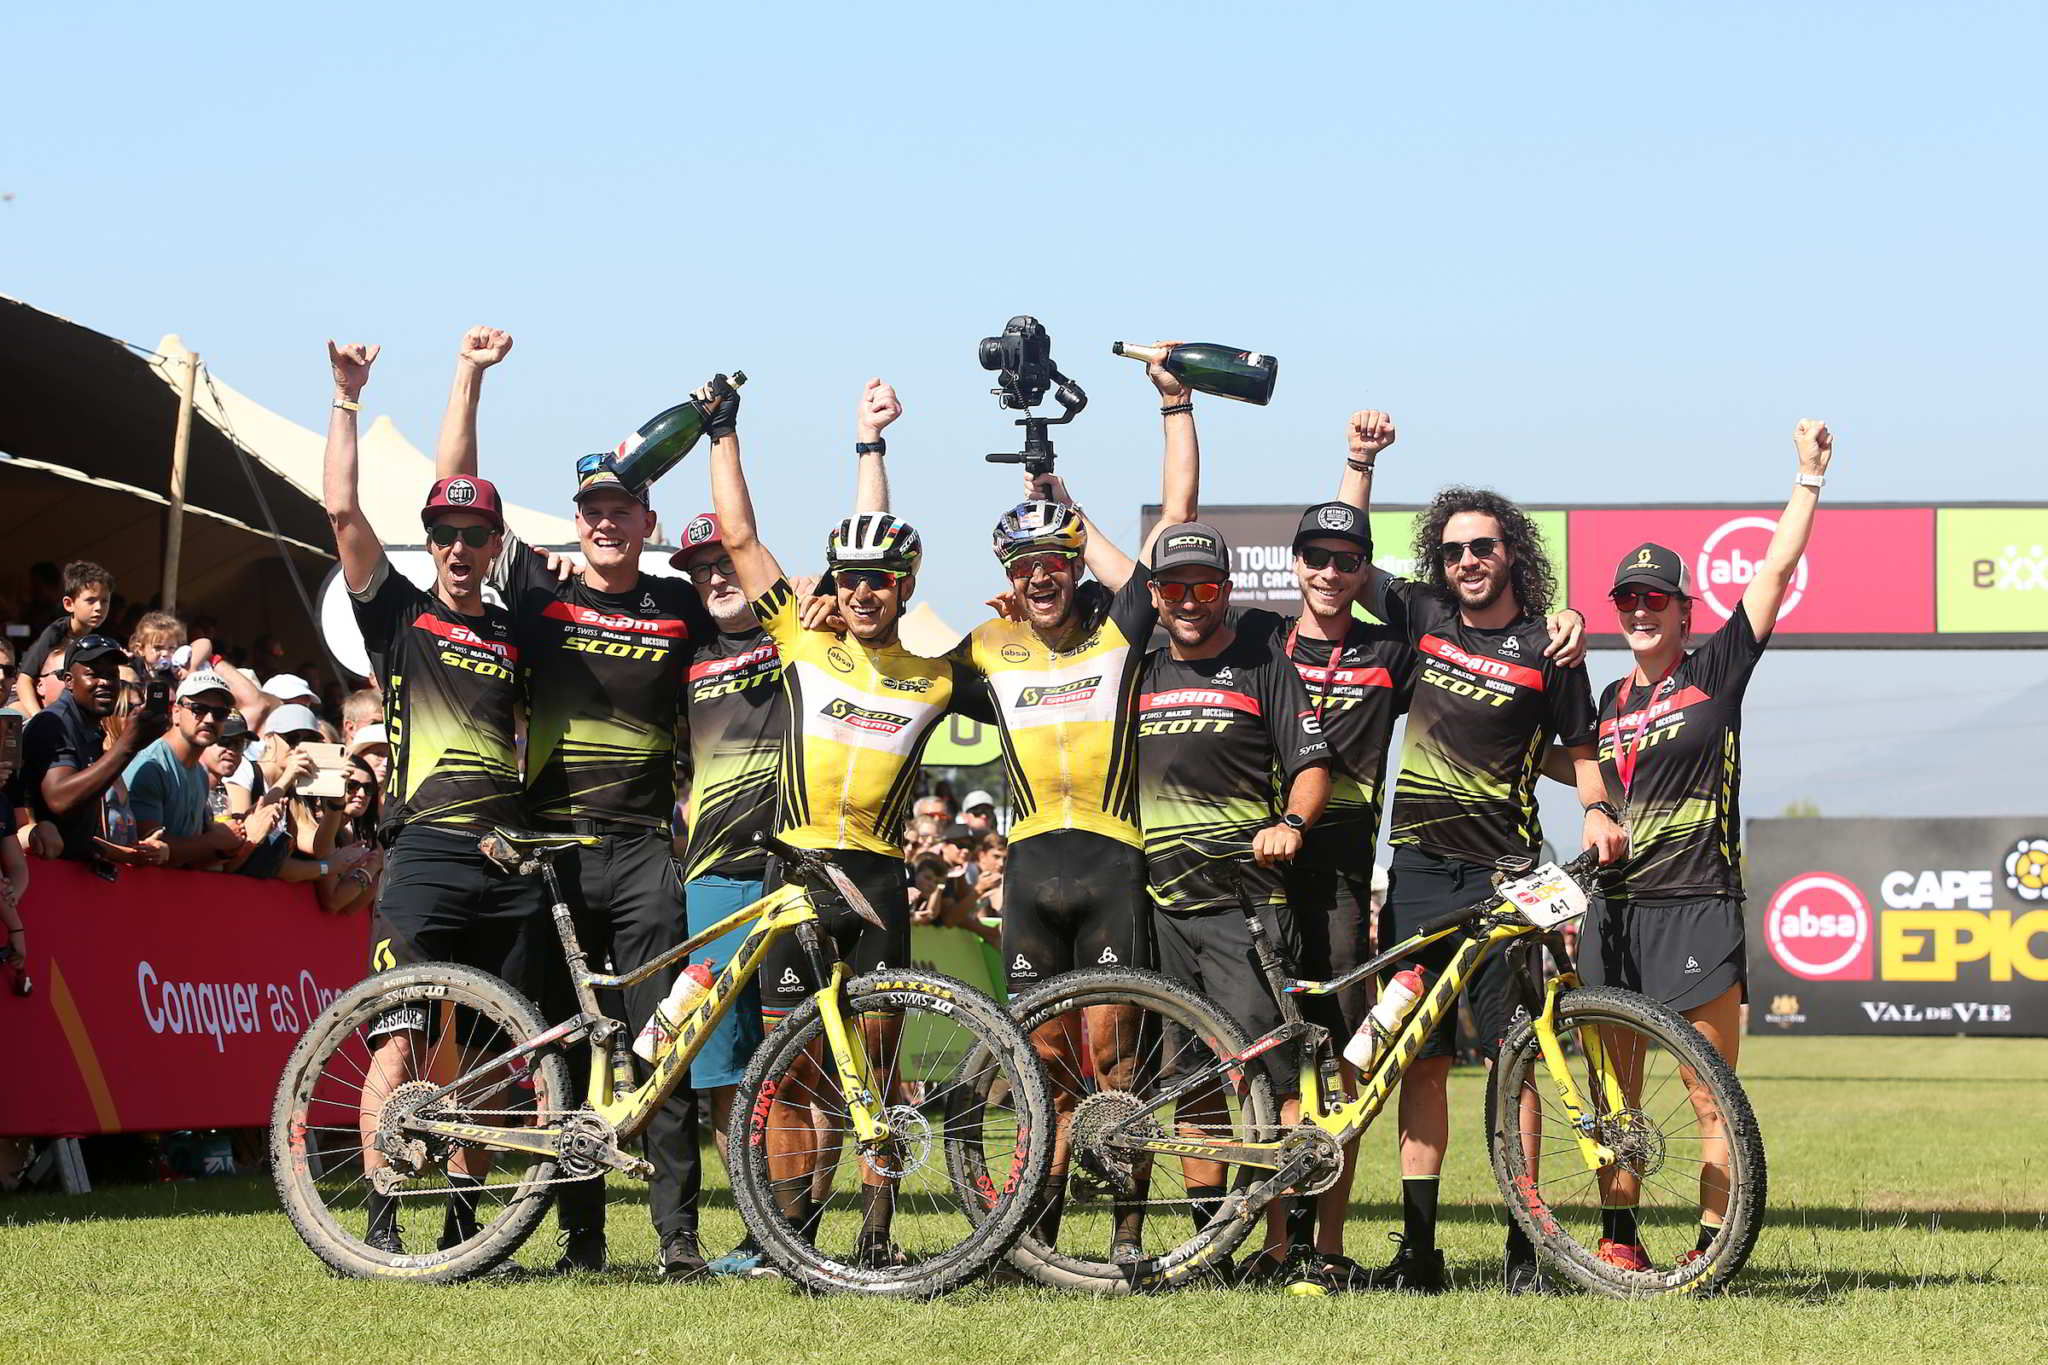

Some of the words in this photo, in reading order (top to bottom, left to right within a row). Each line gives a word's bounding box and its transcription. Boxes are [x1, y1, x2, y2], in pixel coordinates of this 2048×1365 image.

[449, 488, 472, 499] SCOTT
[1168, 535, 1213, 547] SCOTT
[580, 610, 660, 632] SRAM
[562, 637, 670, 662] SCOTT
[1438, 643, 1510, 678] SRAM
[694, 667, 782, 704] SCOTT
[898, 684, 927, 694] EPIC
[1043, 678, 1100, 695] SCOTT
[1421, 668, 1514, 707] SCOTT
[1151, 691, 1225, 706] SRAM
[850, 707, 908, 724] SCOTT
[850, 717, 897, 733] SRAM
[1138, 719, 1235, 738] SCOTT
[1881, 870, 1993, 909] CAPE
[1780, 905, 1856, 938] absa
[385, 986, 421, 1003] SWISS
[776, 985, 805, 993] odlo
[875, 980, 953, 999] MAXXIS
[138, 960, 261, 1053] Conquer
[267, 983, 300, 1034] as
[890, 991, 930, 1007] SWISS
[929, 998, 955, 1015] DT
[1861, 1002, 1922, 1022] VAL
[1953, 1002, 2011, 1022] VIE
[1143, 1141, 1223, 1155] SCOTT
[1174, 1232, 1211, 1262] SWISS
